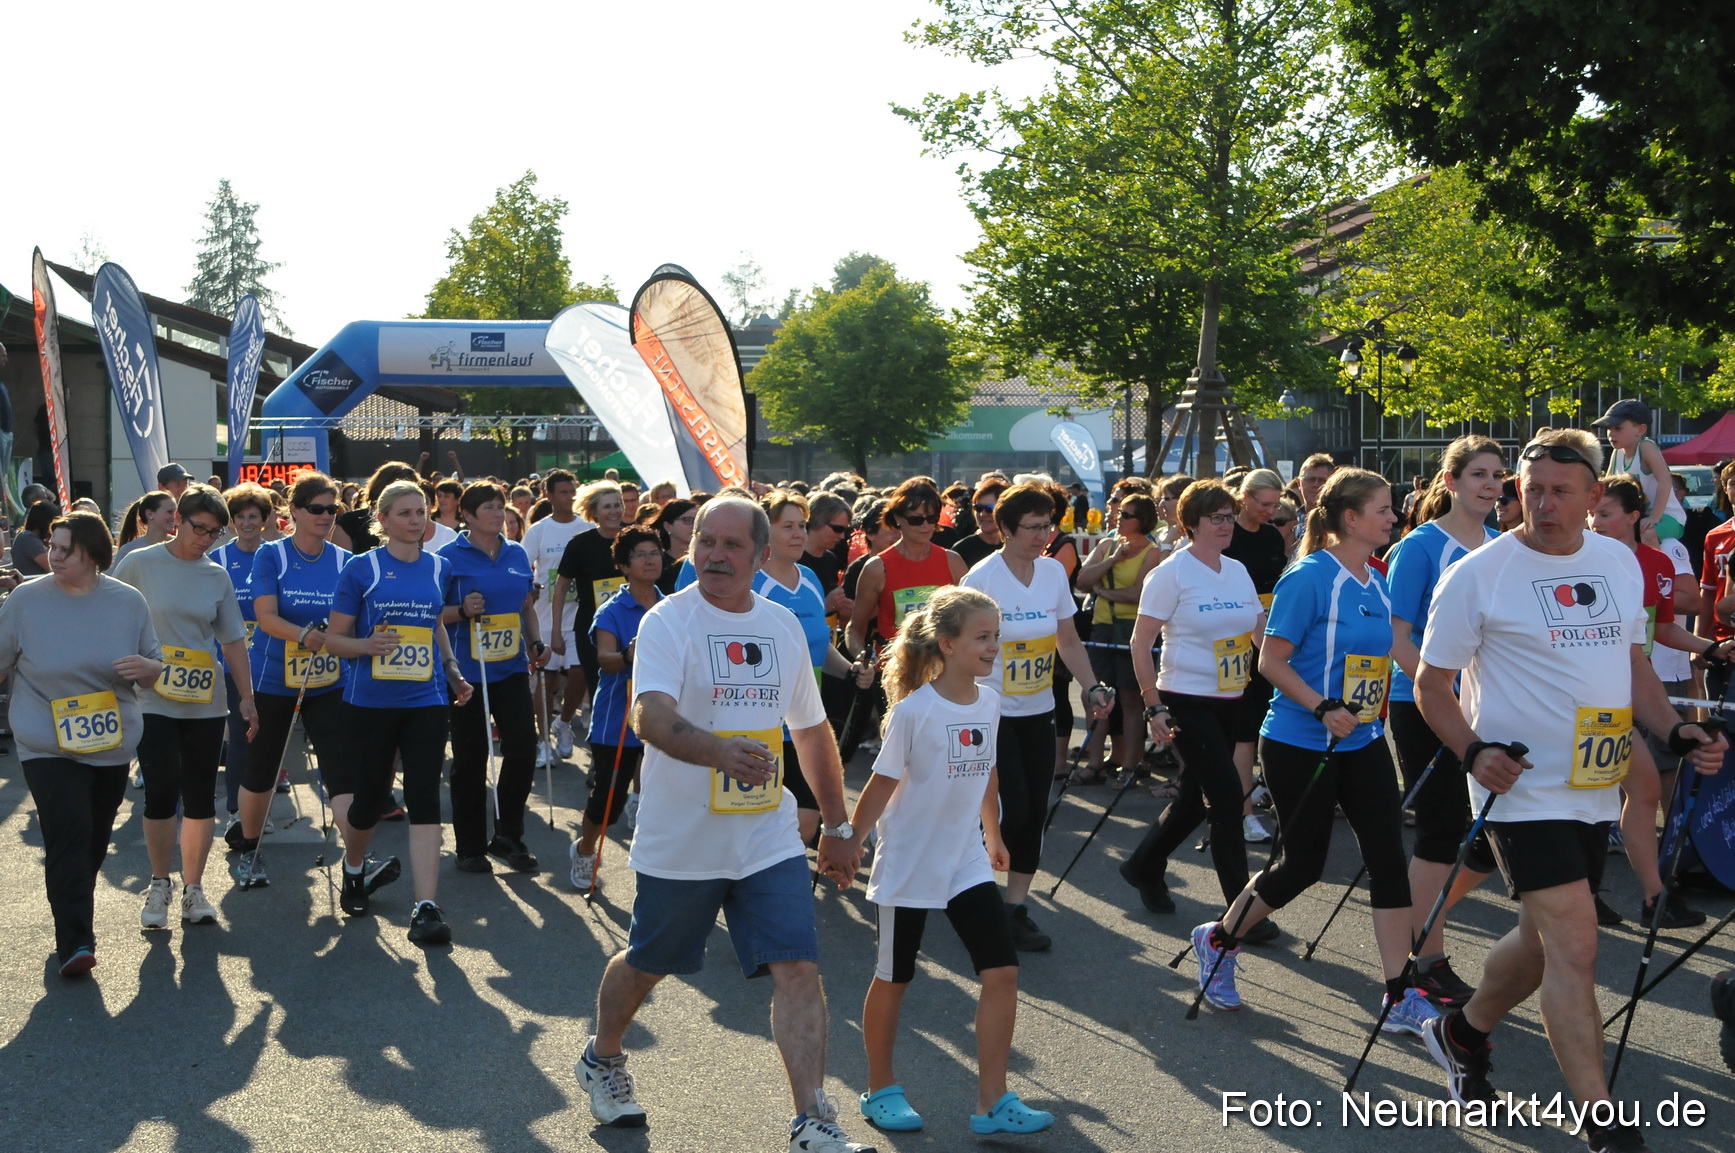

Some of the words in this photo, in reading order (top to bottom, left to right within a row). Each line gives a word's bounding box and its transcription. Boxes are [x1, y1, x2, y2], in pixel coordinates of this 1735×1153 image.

[459, 352, 534, 367] firmenlauf
[311, 376, 353, 386] Fischer
[373, 600, 410, 611] Irgendwann
[482, 629, 513, 649] 478
[1549, 625, 1621, 642] POLGER
[288, 655, 337, 676] 1296
[1006, 653, 1052, 681] 1184
[162, 665, 213, 690] 1368
[712, 687, 779, 701] POLGER
[1352, 678, 1383, 705] 485
[59, 711, 118, 741] 1366
[1578, 731, 1632, 768] 1005
[948, 762, 990, 774] POLGER
